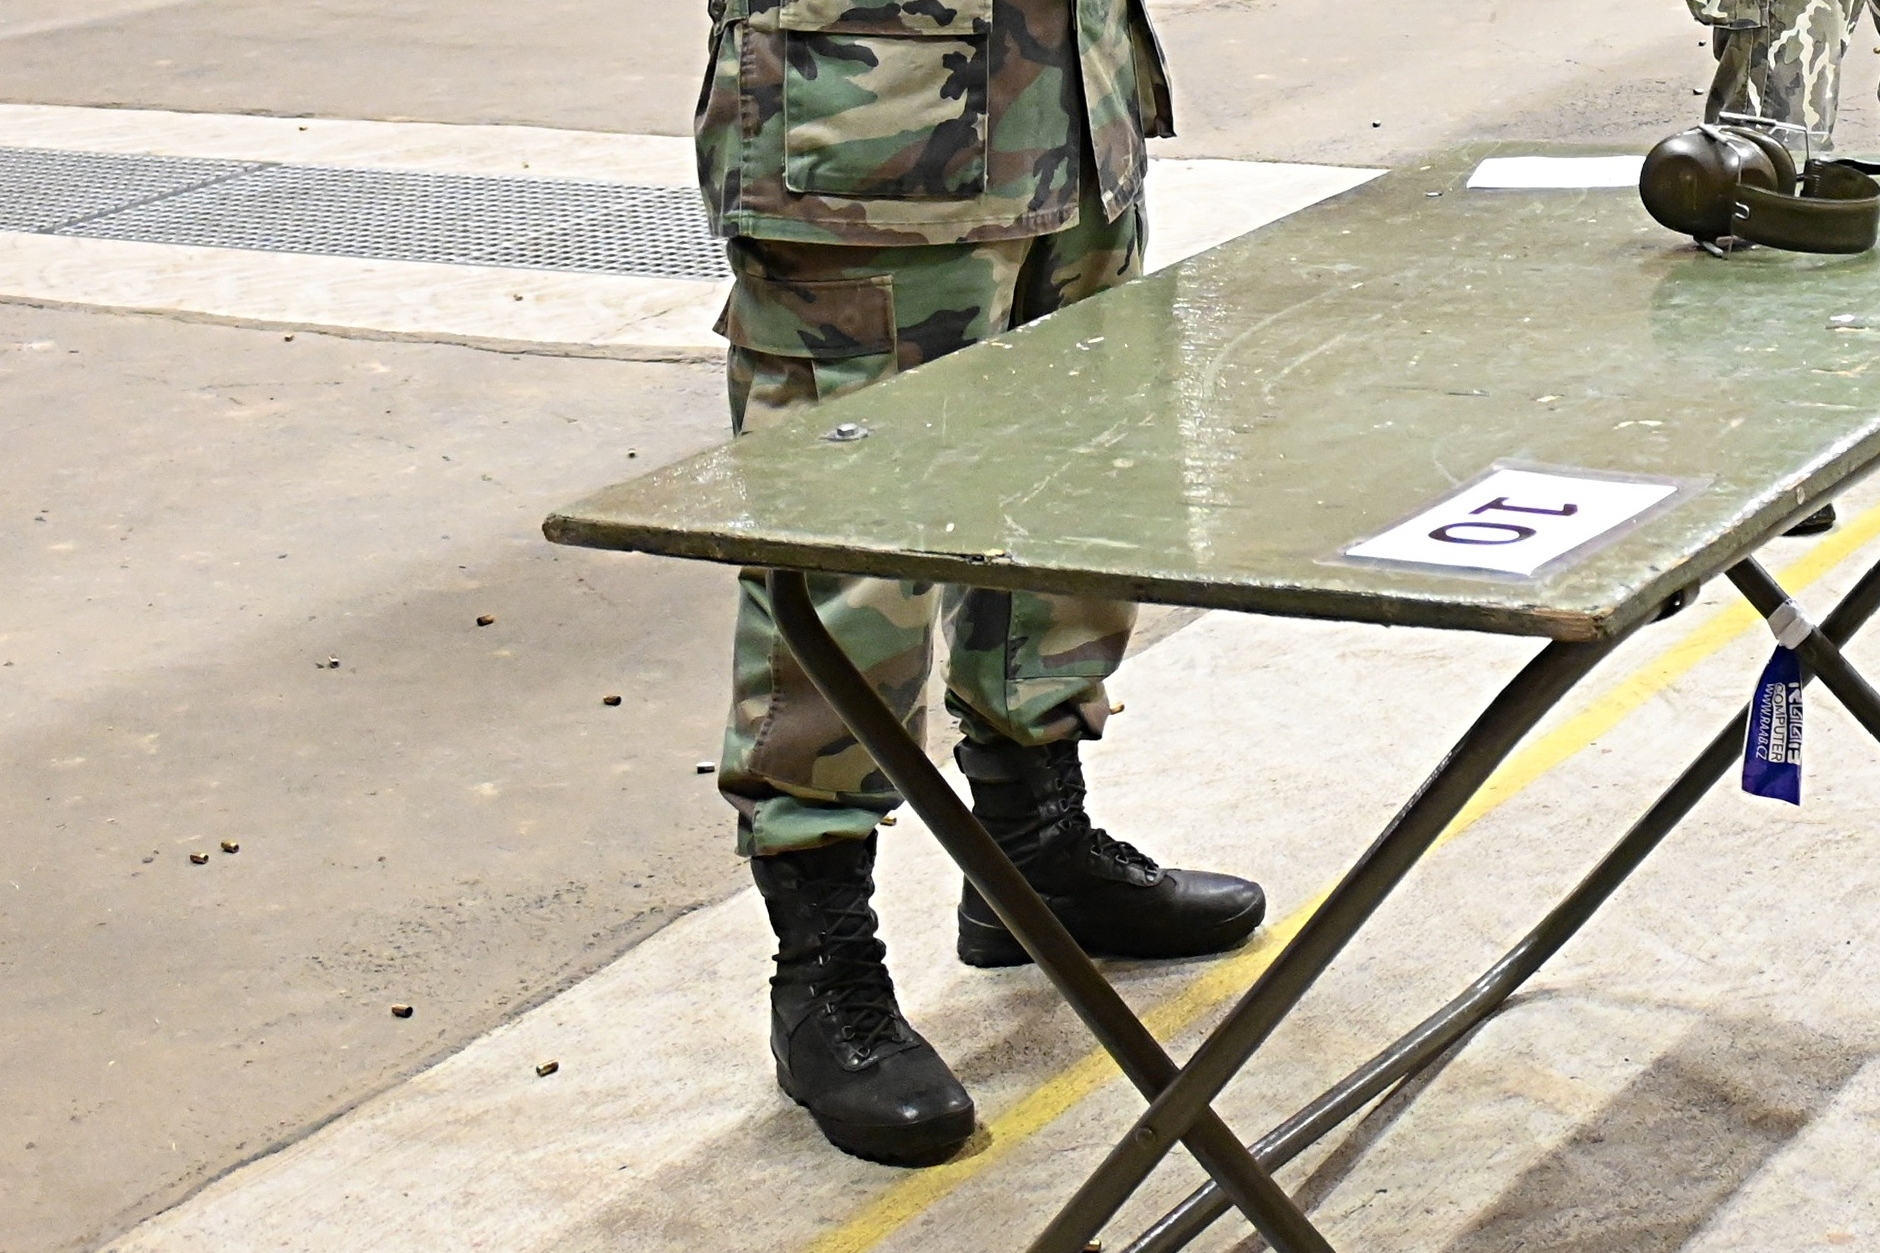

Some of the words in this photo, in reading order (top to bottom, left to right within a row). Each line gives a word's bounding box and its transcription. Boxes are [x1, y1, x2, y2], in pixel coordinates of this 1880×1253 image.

[1427, 496, 1579, 546] 10
[1755, 683, 1775, 761] WWW.RAAB.CZ
[1771, 683, 1785, 762] COMPUTER
